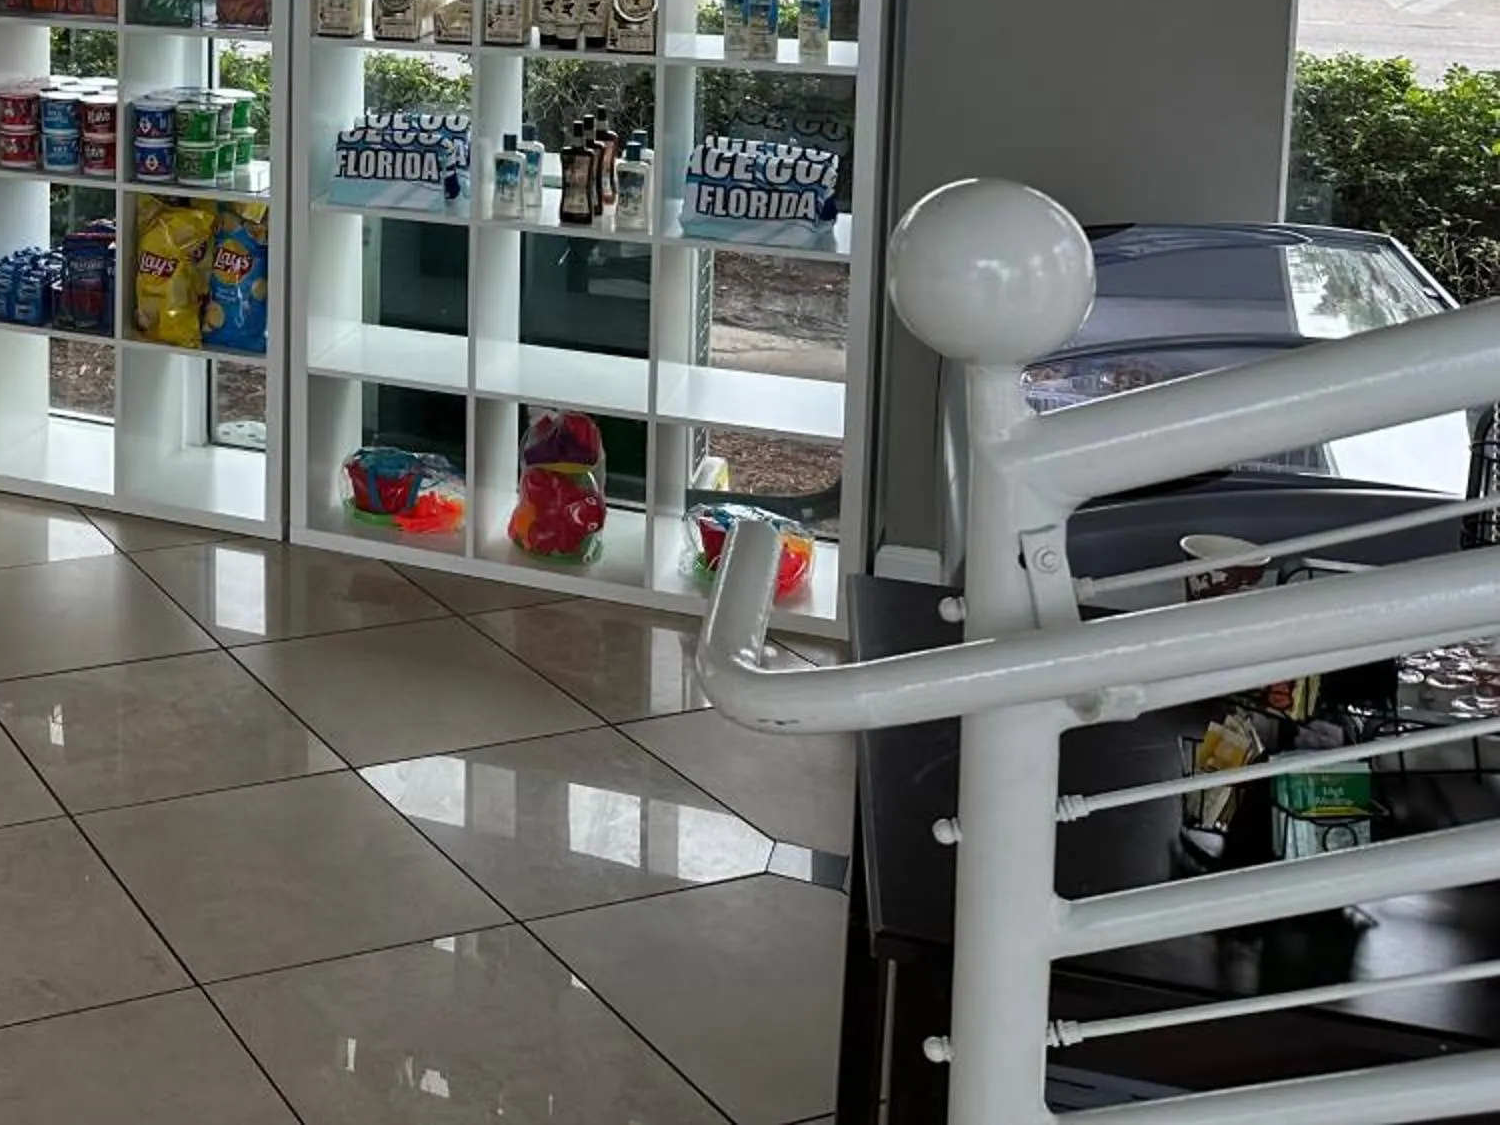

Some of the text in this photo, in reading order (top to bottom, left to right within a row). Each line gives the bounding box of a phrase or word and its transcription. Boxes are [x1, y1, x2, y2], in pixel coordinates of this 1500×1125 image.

[336, 148, 439, 181] FLORIDA
[698, 184, 816, 220] FLORIDA
[140, 252, 175, 277] Lay's
[214, 249, 250, 275] Lay's
